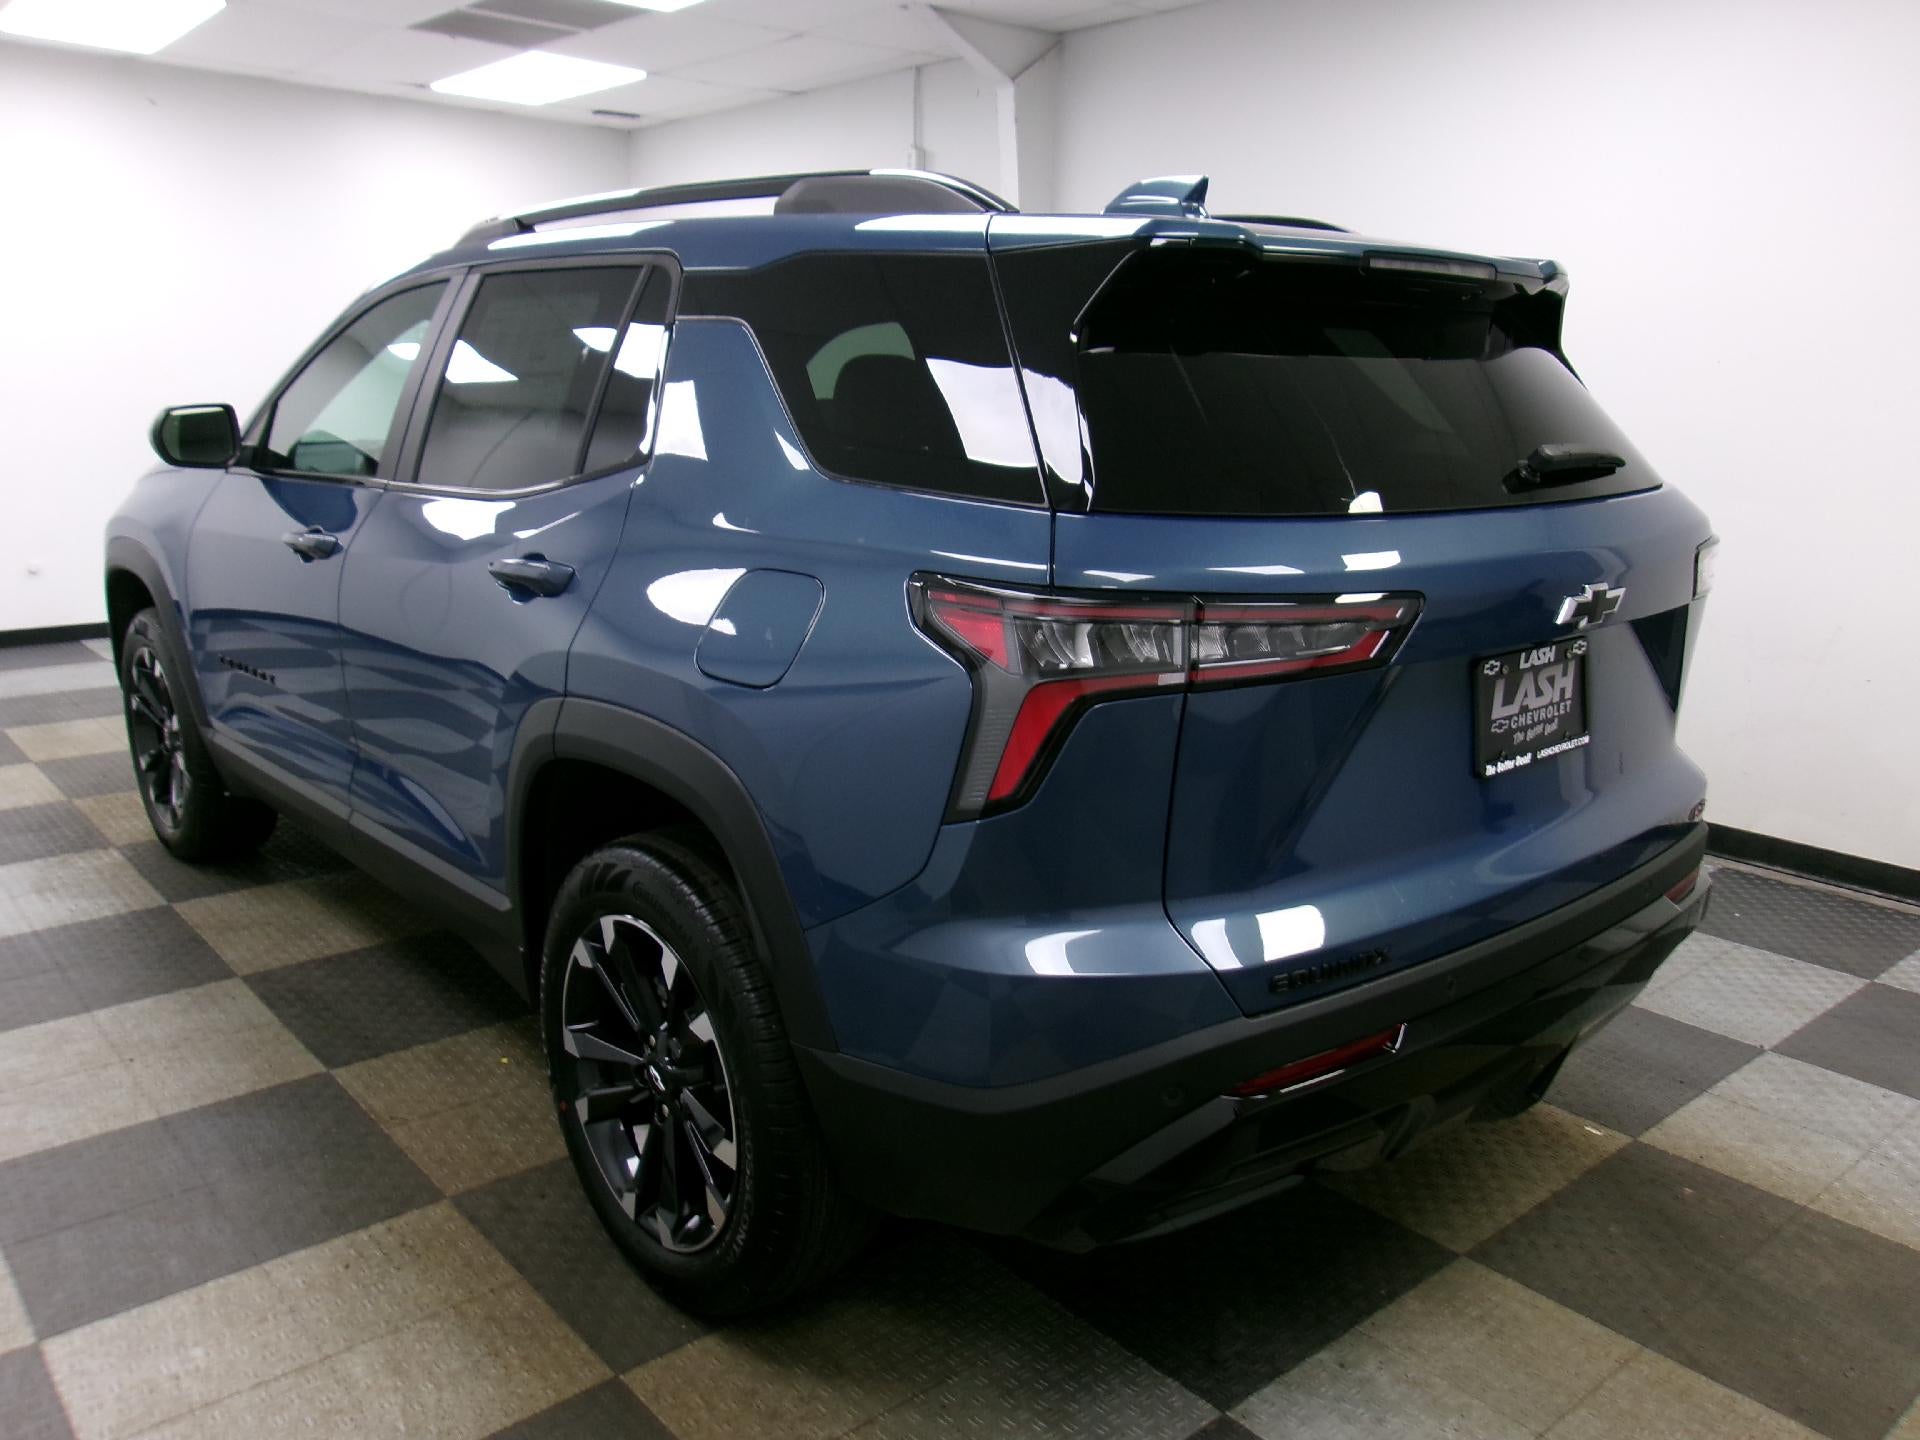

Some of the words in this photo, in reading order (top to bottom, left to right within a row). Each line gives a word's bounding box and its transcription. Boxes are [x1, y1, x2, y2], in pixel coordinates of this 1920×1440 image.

[1519, 645, 1556, 670] LASH
[1490, 660, 1576, 721] LASH
[1510, 700, 1572, 729] CHEVROLET
